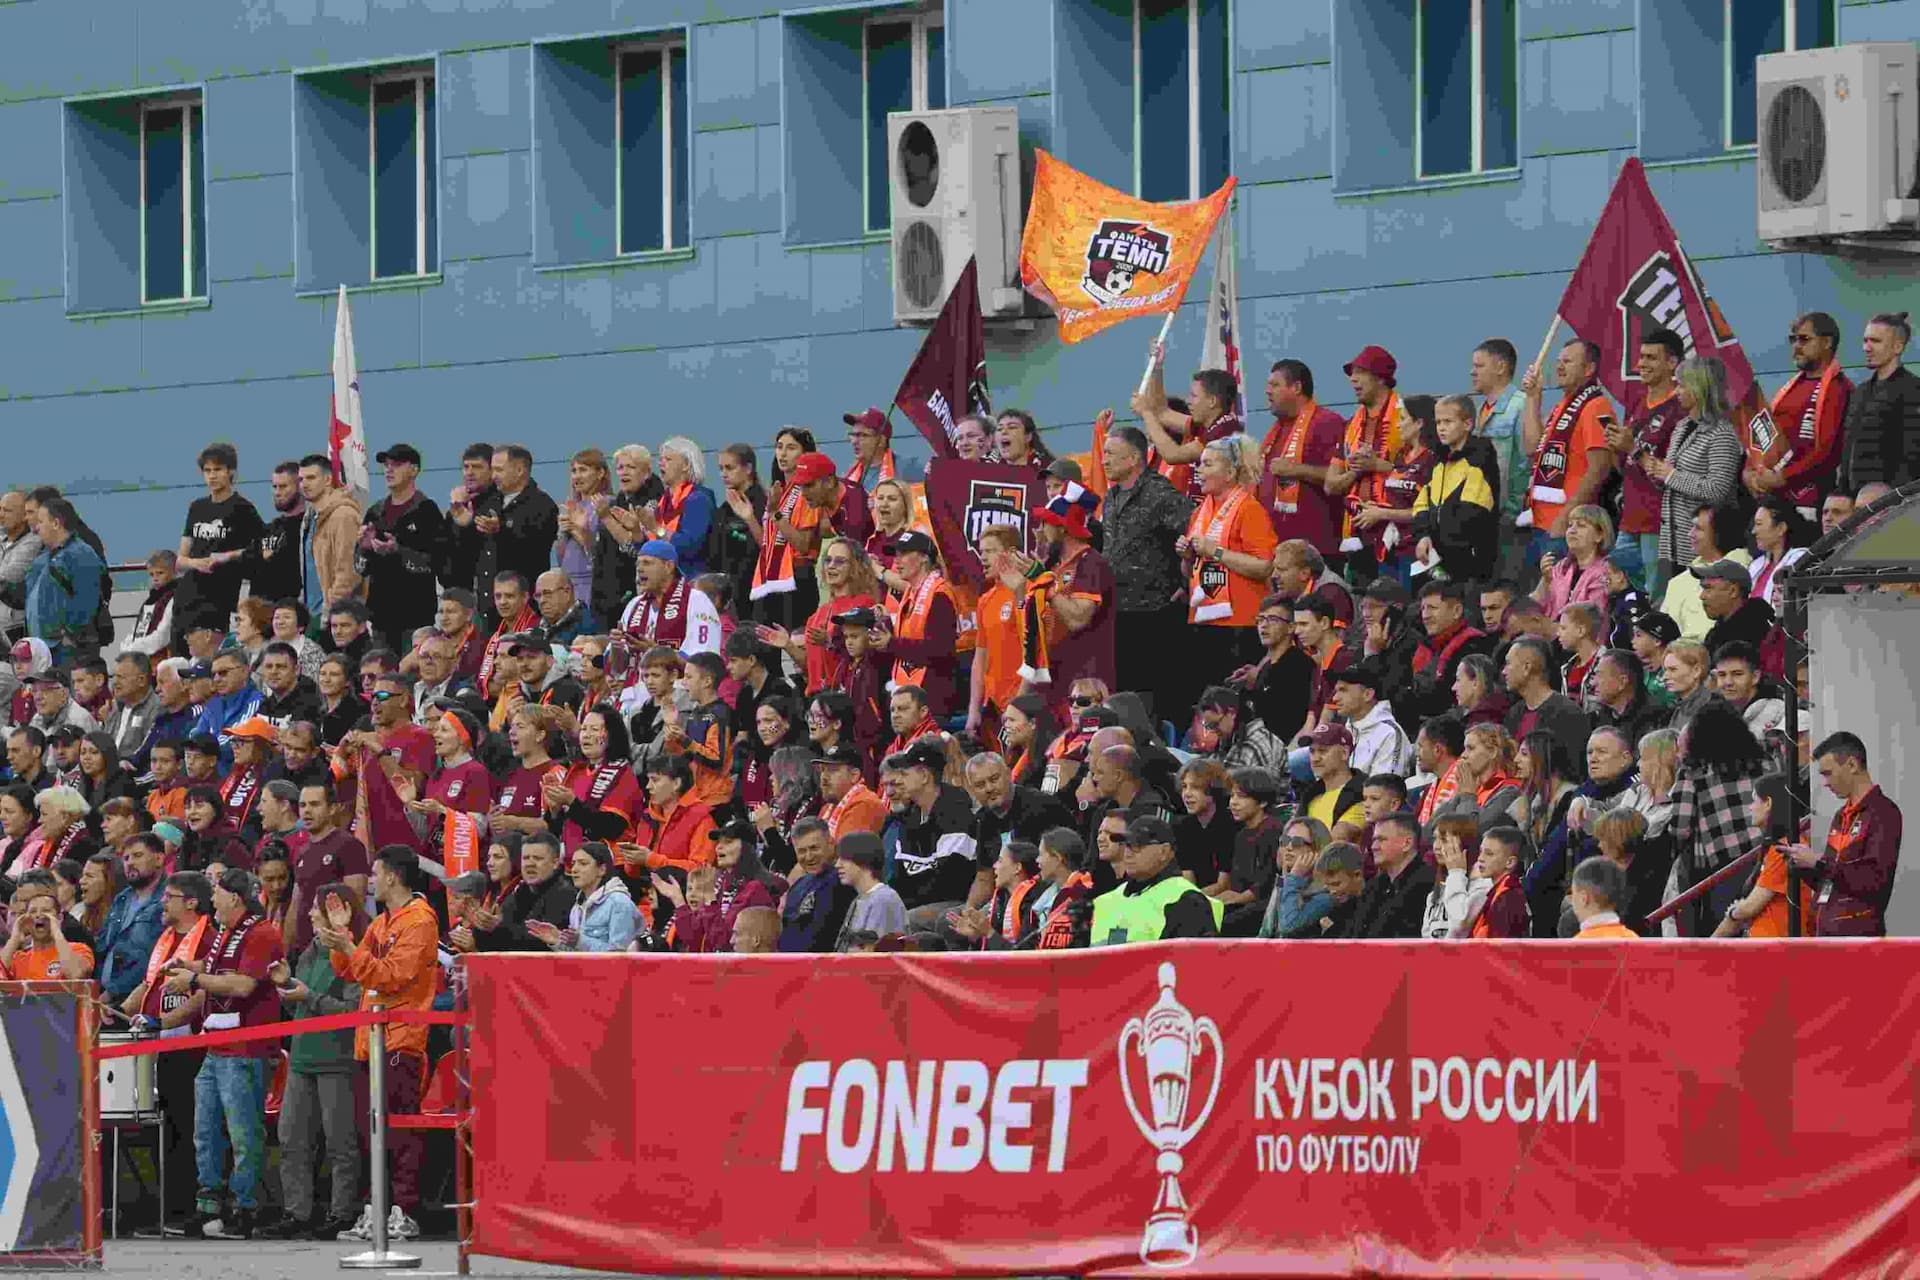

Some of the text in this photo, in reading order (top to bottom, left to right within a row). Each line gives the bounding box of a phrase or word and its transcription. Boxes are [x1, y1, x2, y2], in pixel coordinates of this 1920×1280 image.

[1097, 238, 1165, 274] ТЕМП
[1109, 230, 1158, 251] ФАНАТЫ
[1203, 572, 1225, 585] ЕМП
[698, 624, 709, 645] 8
[1254, 1056, 1598, 1124] КУБОК РОССИИ
[780, 1058, 1089, 1173] FONBET
[1256, 1133, 1421, 1175] ПО ФУТБОЛУ
